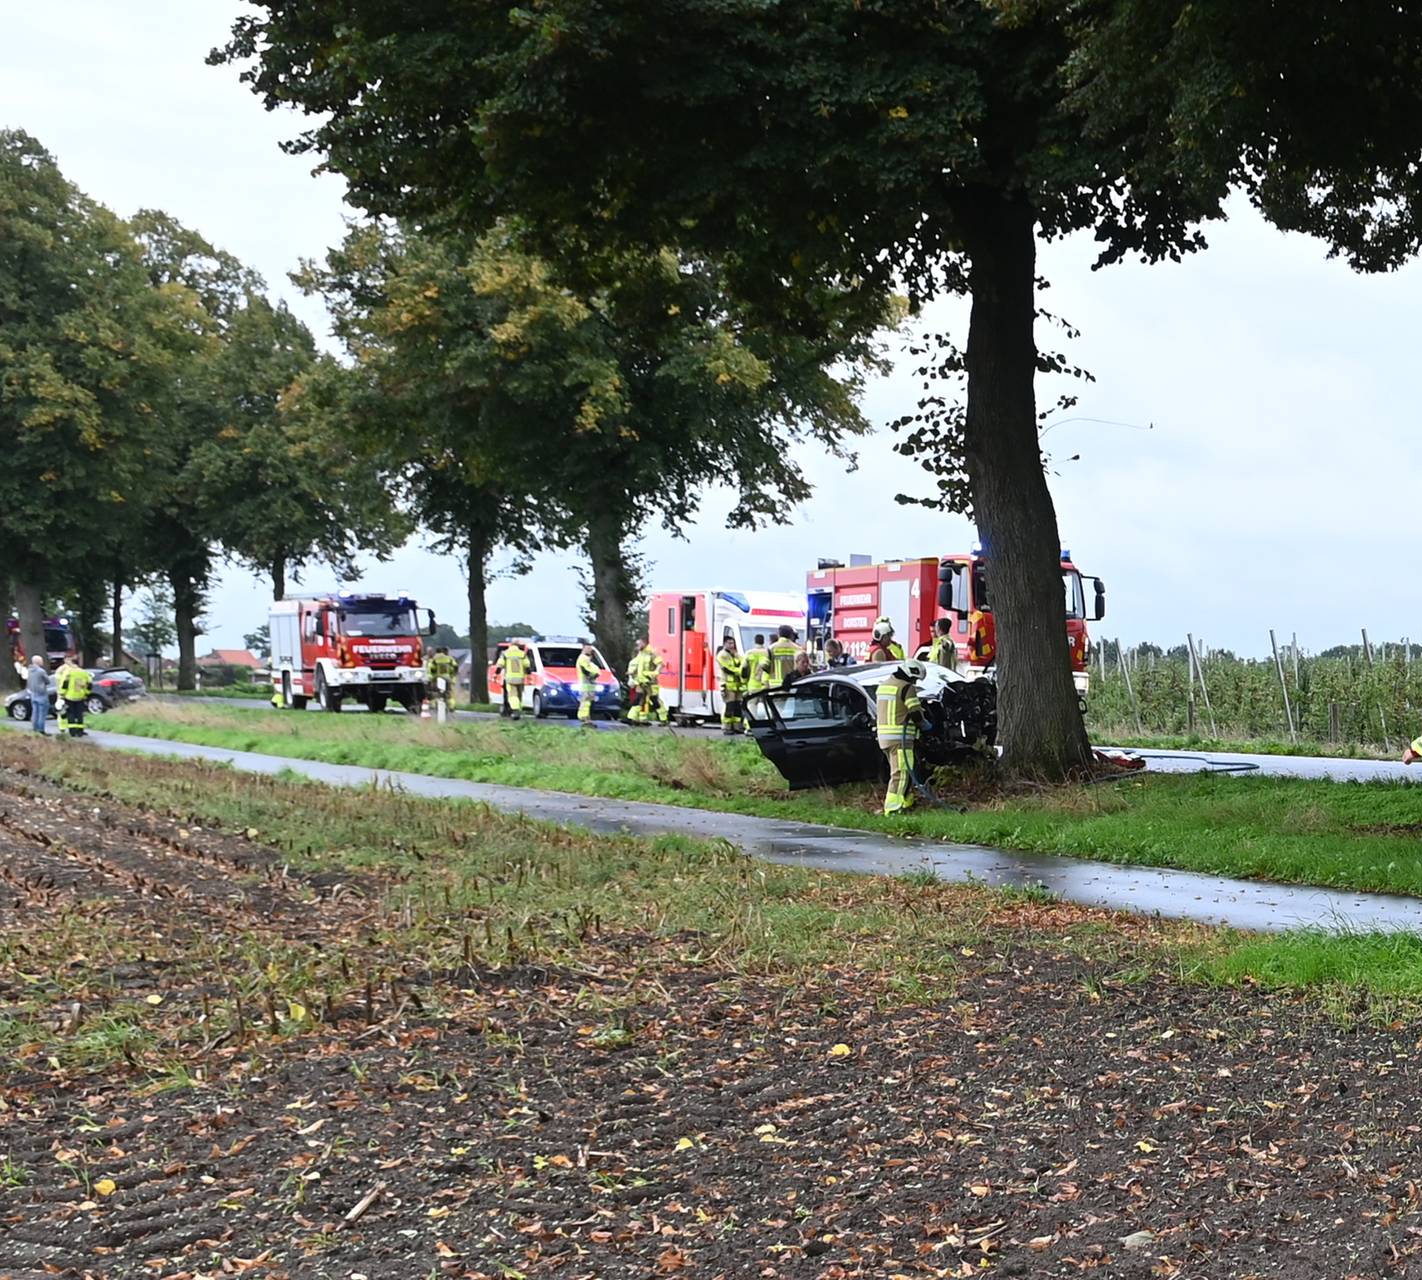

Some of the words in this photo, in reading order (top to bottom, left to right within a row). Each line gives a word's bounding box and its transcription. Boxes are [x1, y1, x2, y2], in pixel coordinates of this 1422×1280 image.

[911, 578, 920, 598] 4
[352, 645, 412, 654] FEUERWEHR
[850, 641, 868, 657] 112
